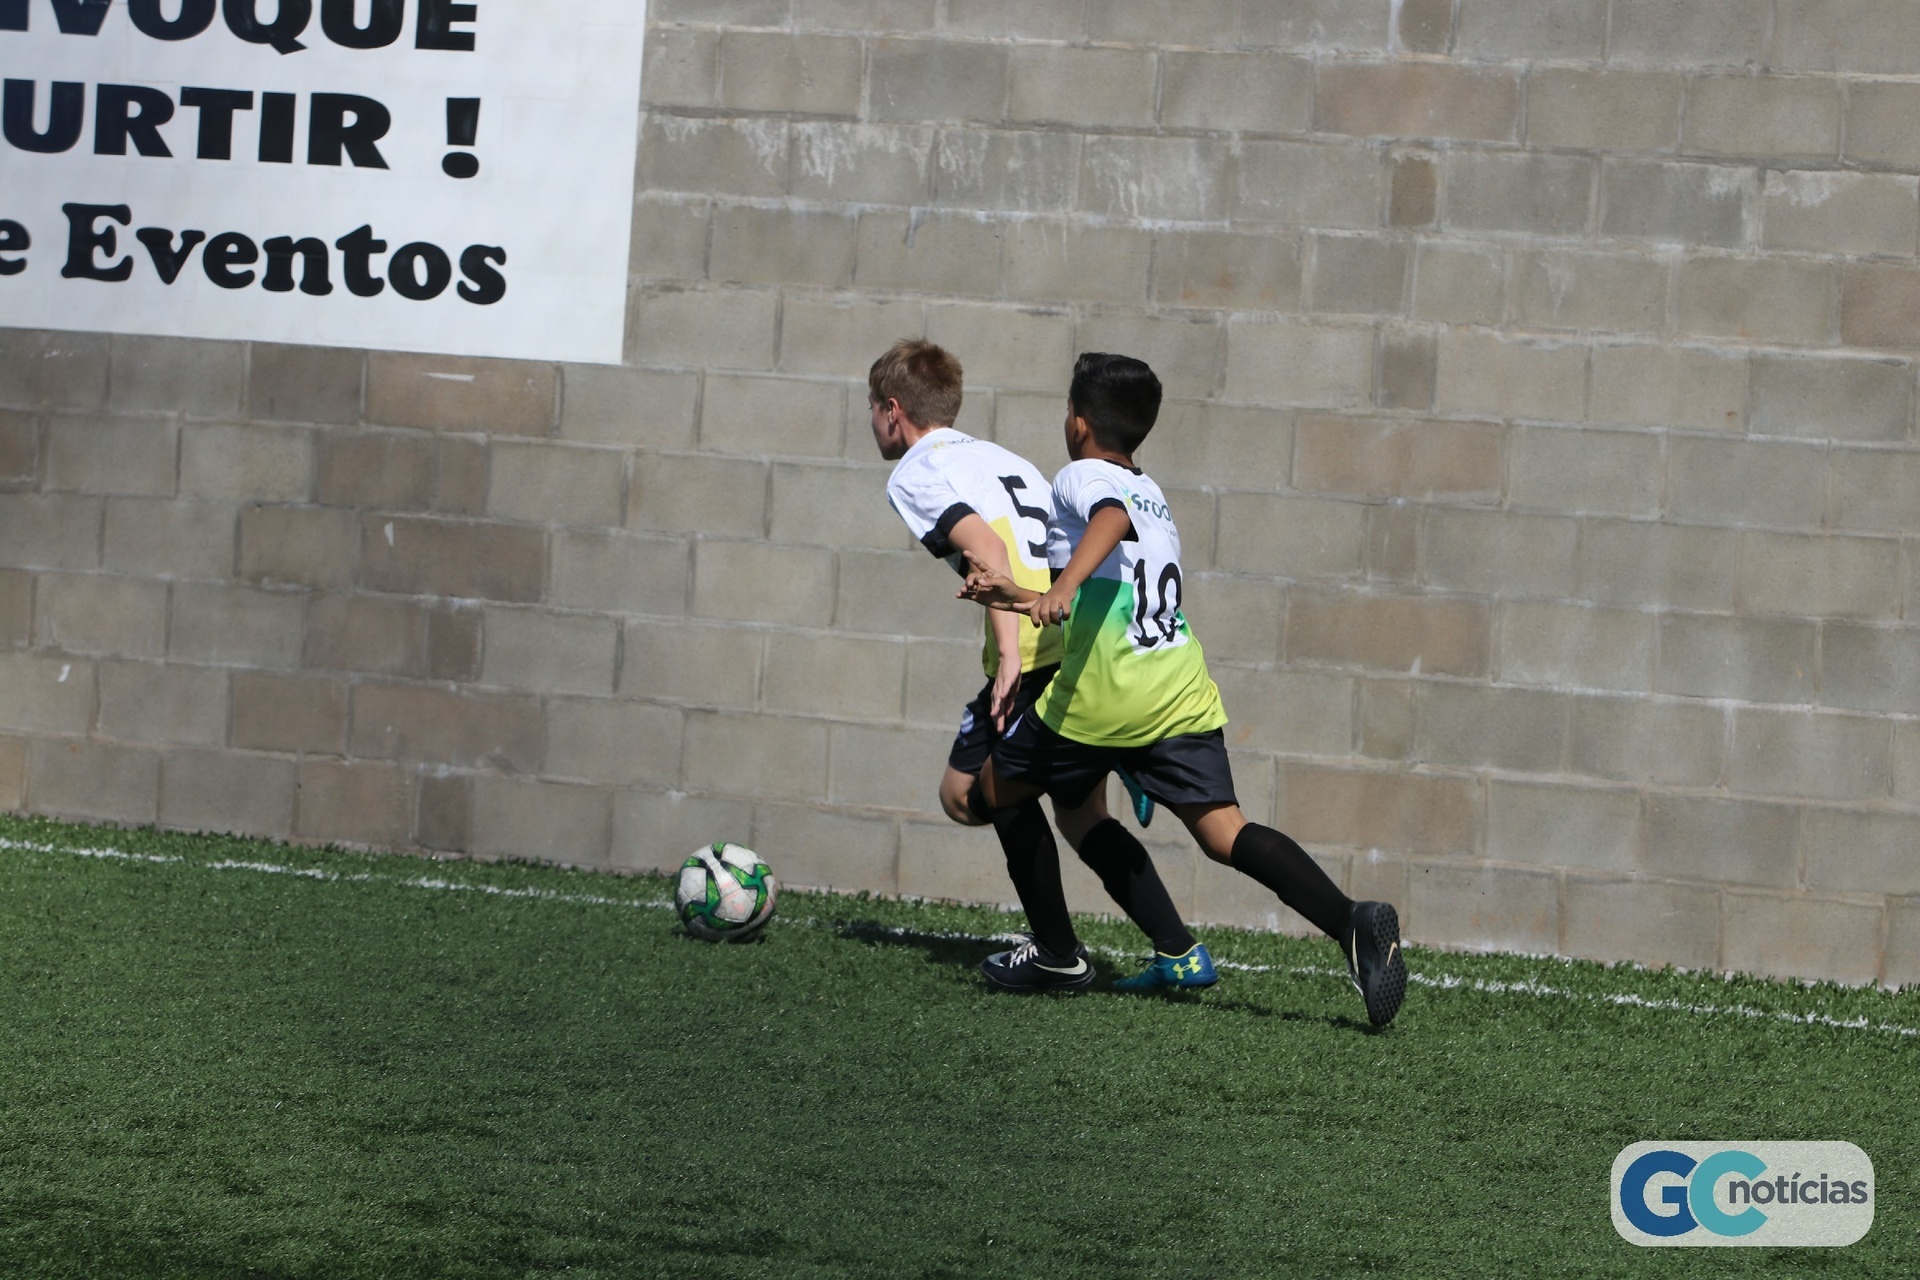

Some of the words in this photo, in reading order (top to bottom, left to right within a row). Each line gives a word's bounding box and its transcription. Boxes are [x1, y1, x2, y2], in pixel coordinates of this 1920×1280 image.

[3, 79, 391, 169] URTIR
[61, 202, 507, 305] Eventos
[998, 475, 1049, 558] 5
[1133, 558, 1182, 648] 10
